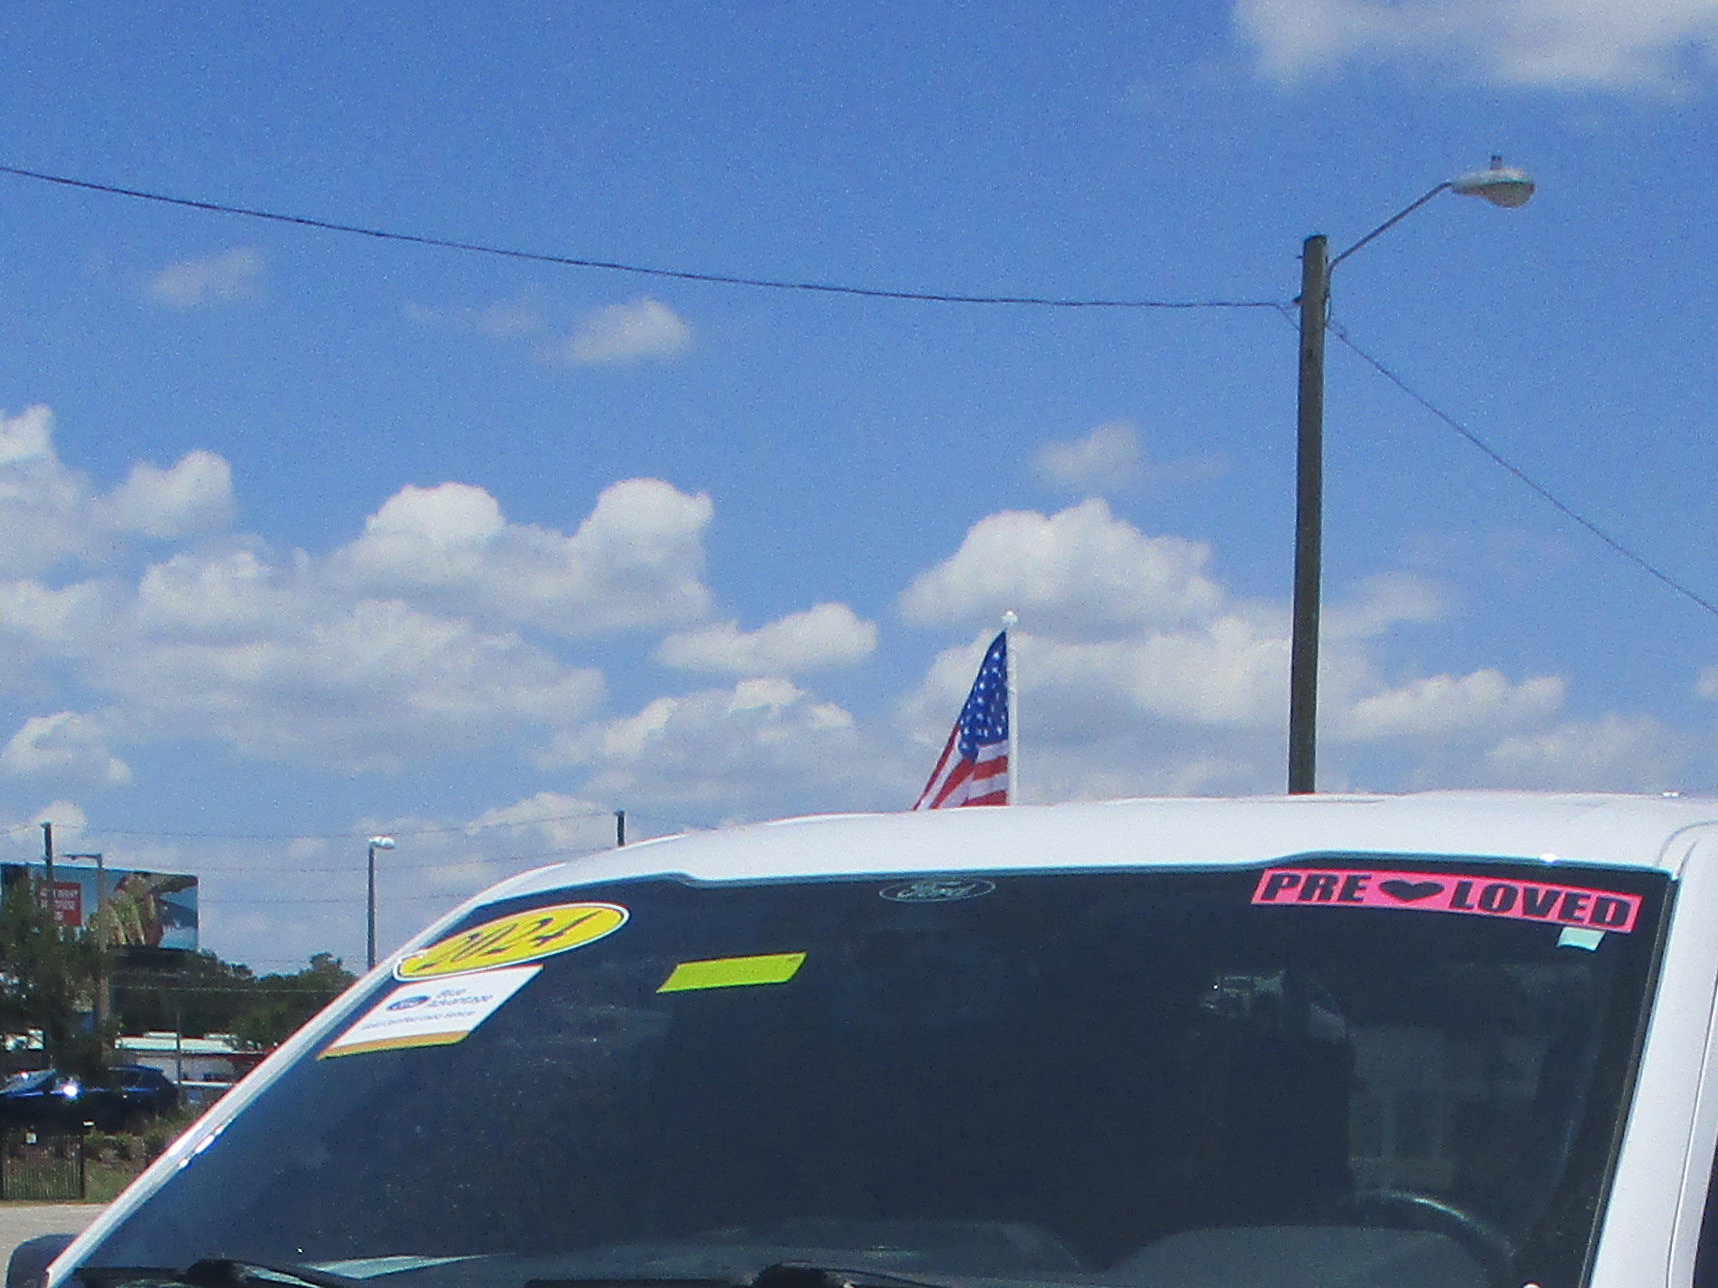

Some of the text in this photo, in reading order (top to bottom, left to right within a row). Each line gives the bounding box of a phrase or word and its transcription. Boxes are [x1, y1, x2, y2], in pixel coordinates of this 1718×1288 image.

[1260, 872, 1631, 928] PRE LOVED
[412, 910, 603, 972] 2024
